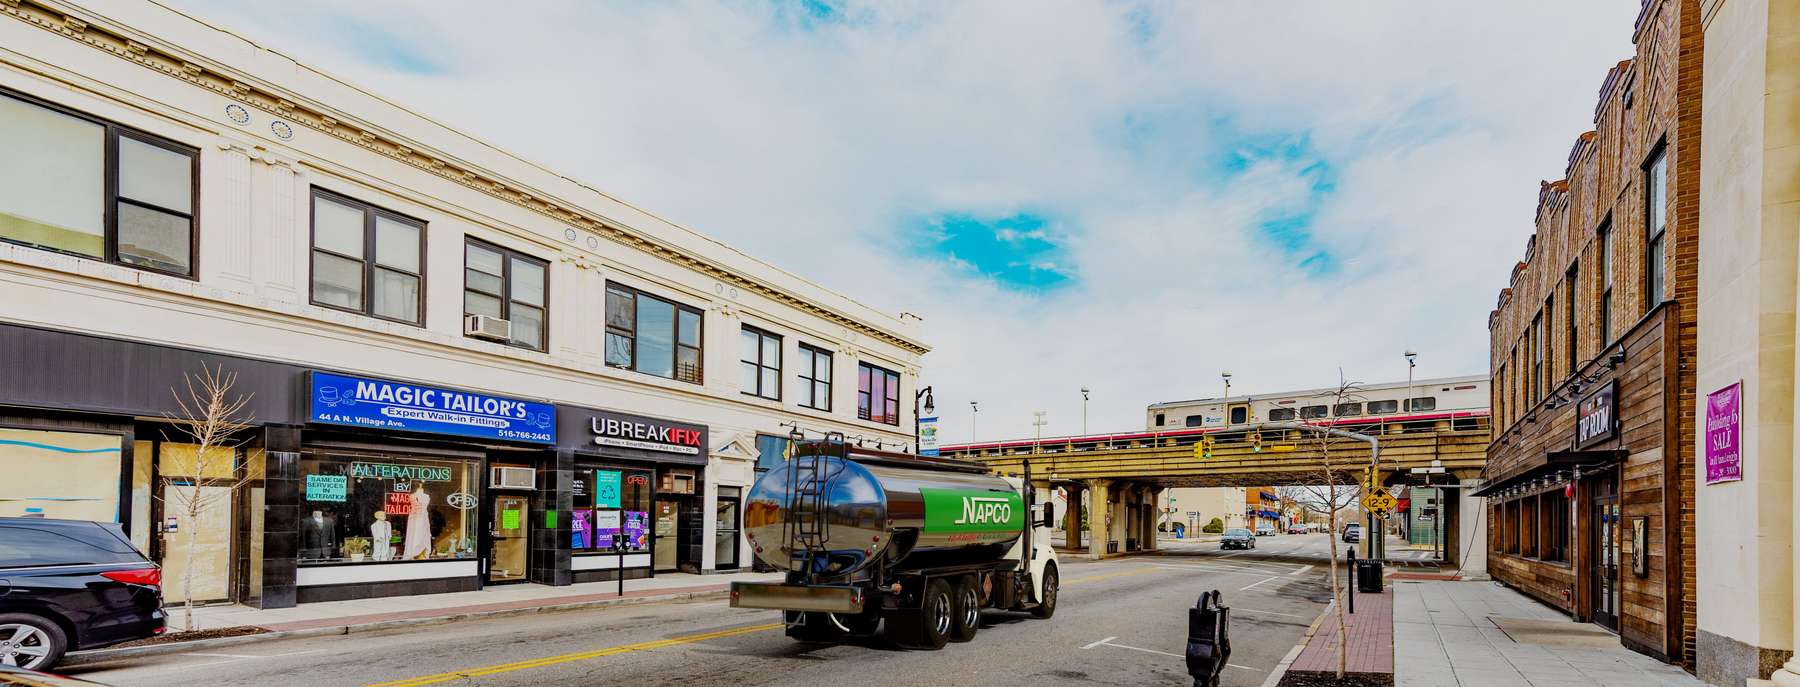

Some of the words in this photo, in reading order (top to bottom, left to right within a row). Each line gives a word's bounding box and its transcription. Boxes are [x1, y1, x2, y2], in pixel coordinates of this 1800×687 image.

[355, 381, 435, 407] MAGIC
[441, 392, 527, 418] TAILOR'S
[355, 416, 386, 427] Village
[387, 419, 406, 428] Ave.
[387, 406, 425, 418] Expert
[428, 411, 466, 424] Walk-in
[469, 415, 507, 429] Fittings
[1580, 415, 1589, 442] TAP
[1590, 405, 1609, 438] ROOM
[591, 416, 701, 446] UBREAKIFIX
[1713, 430, 1732, 451] SALE
[354, 463, 450, 480] ALTERATIONS
[627, 476, 648, 485] OPEN
[396, 482, 410, 491] BY
[386, 503, 411, 514] TAILO
[449, 496, 476, 507] OPEN
[955, 496, 1011, 524] NAPCO
